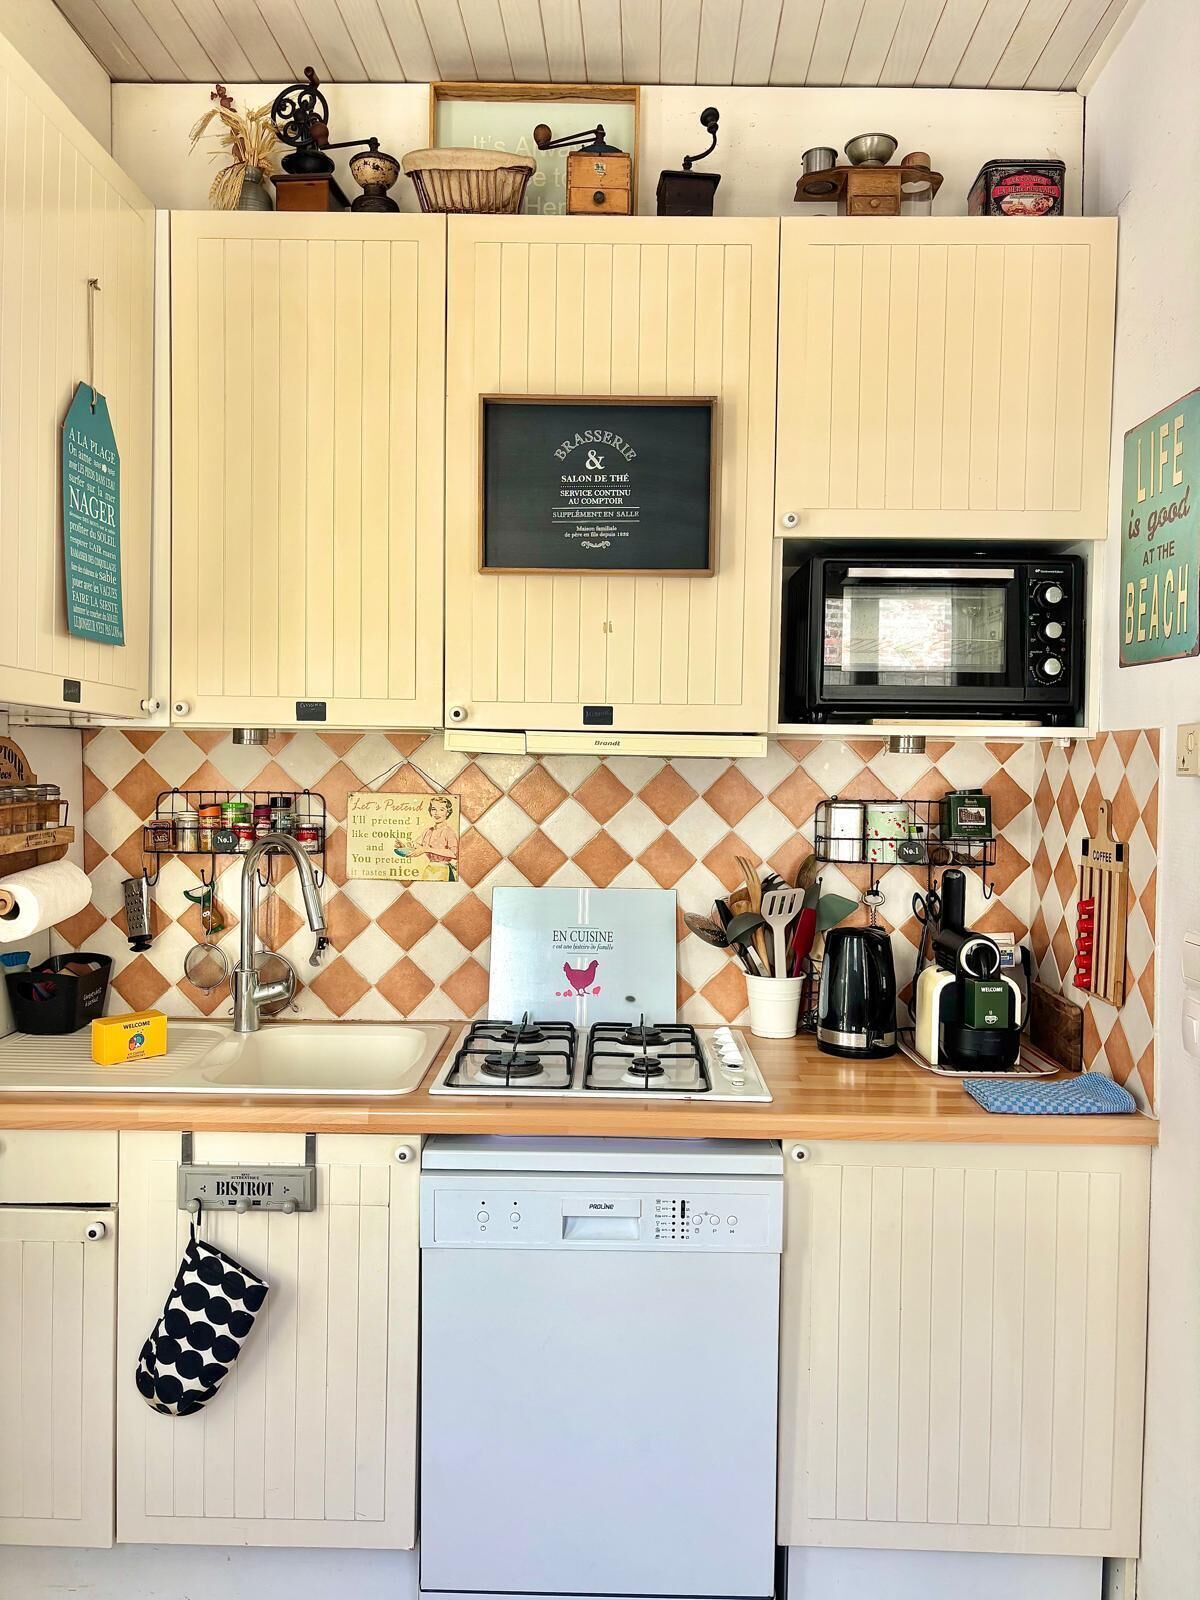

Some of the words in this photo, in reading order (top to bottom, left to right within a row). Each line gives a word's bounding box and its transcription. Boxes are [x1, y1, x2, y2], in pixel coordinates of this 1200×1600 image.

[68, 427, 75, 442] A
[77, 431, 88, 449] LA
[90, 439, 116, 465] PLAGE
[68, 442, 78, 457] On
[554, 429, 637, 462] BRASSERIE
[585, 449, 605, 470] &
[1136, 414, 1184, 503] LIFE
[561, 474, 593, 483] SALON
[594, 474, 608, 482] DE
[609, 472, 630, 482] THÉ
[560, 489, 592, 497] SERVICE
[69, 484, 116, 528] NAGER
[1128, 508, 1141, 540] is
[1147, 485, 1191, 542] good
[552, 510, 603, 518] SUPPLÉMENT
[1142, 547, 1155, 567] AT
[1157, 540, 1176, 564] THE
[98, 570, 117, 585] sable
[72, 590, 90, 606] FAIRE
[90, 596, 99, 608] LA
[100, 600, 118, 614] SIESTE
[1124, 563, 1190, 645] BEACH
[351, 797, 382, 811] Let's
[384, 798, 424, 812] Pretend
[352, 815, 366, 824] I'll
[371, 816, 411, 826] pretend
[217, 836, 233, 844] No.1
[351, 830, 369, 839] like
[372, 829, 413, 840] cooking
[366, 843, 384, 852] and
[902, 847, 920, 856] No.1
[352, 854, 372, 864] You
[375, 856, 412, 865] pretend
[1092, 849, 1112, 864] COFFEE
[362, 868, 387, 877] tastes
[389, 866, 420, 877] nice
[552, 930, 568, 942] EN
[570, 930, 614, 943] CUISINE
[122, 1020, 151, 1031] WELCOME
[216, 1181, 274, 1196] BISTROT
